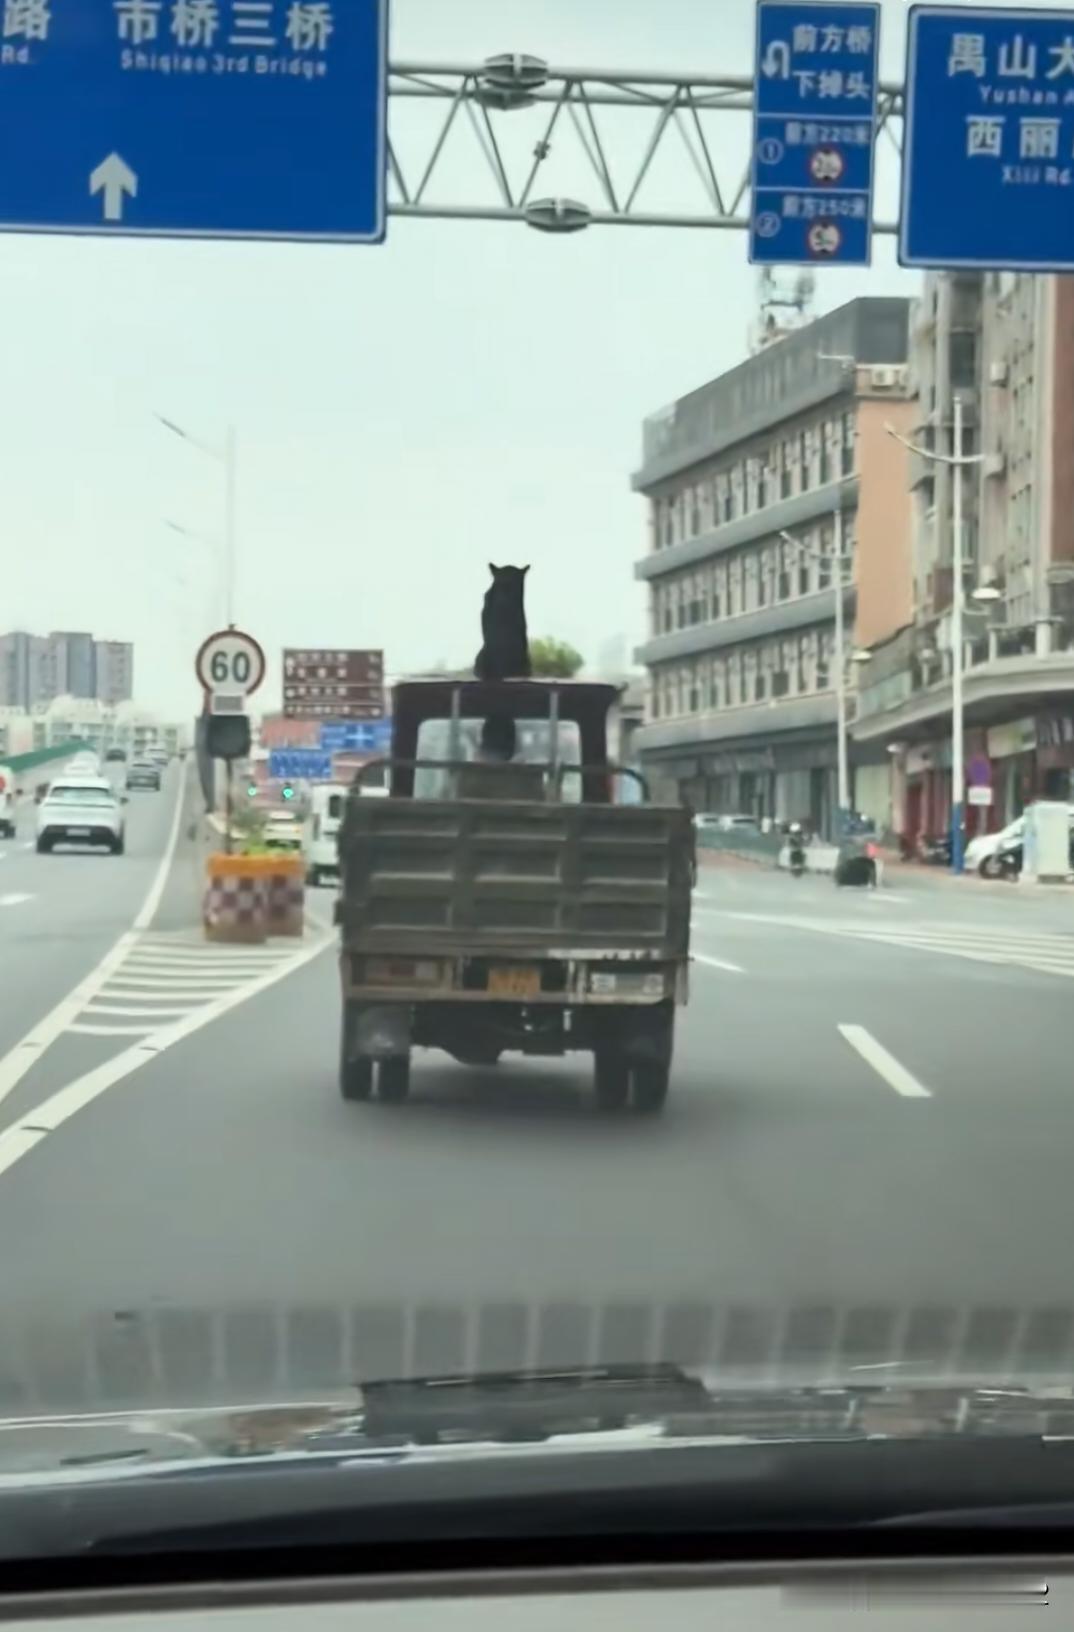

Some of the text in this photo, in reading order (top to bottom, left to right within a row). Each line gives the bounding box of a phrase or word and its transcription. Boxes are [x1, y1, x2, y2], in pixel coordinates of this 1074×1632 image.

[3, 0, 51, 40] 路
[113, 0, 334, 51] 市桥三桥
[212, 53, 249, 74] 3rd
[255, 55, 327, 79] Bridge
[948, 33, 1074, 79] 禺山大
[965, 115, 1074, 158] 西丽
[211, 651, 250, 683] 60
